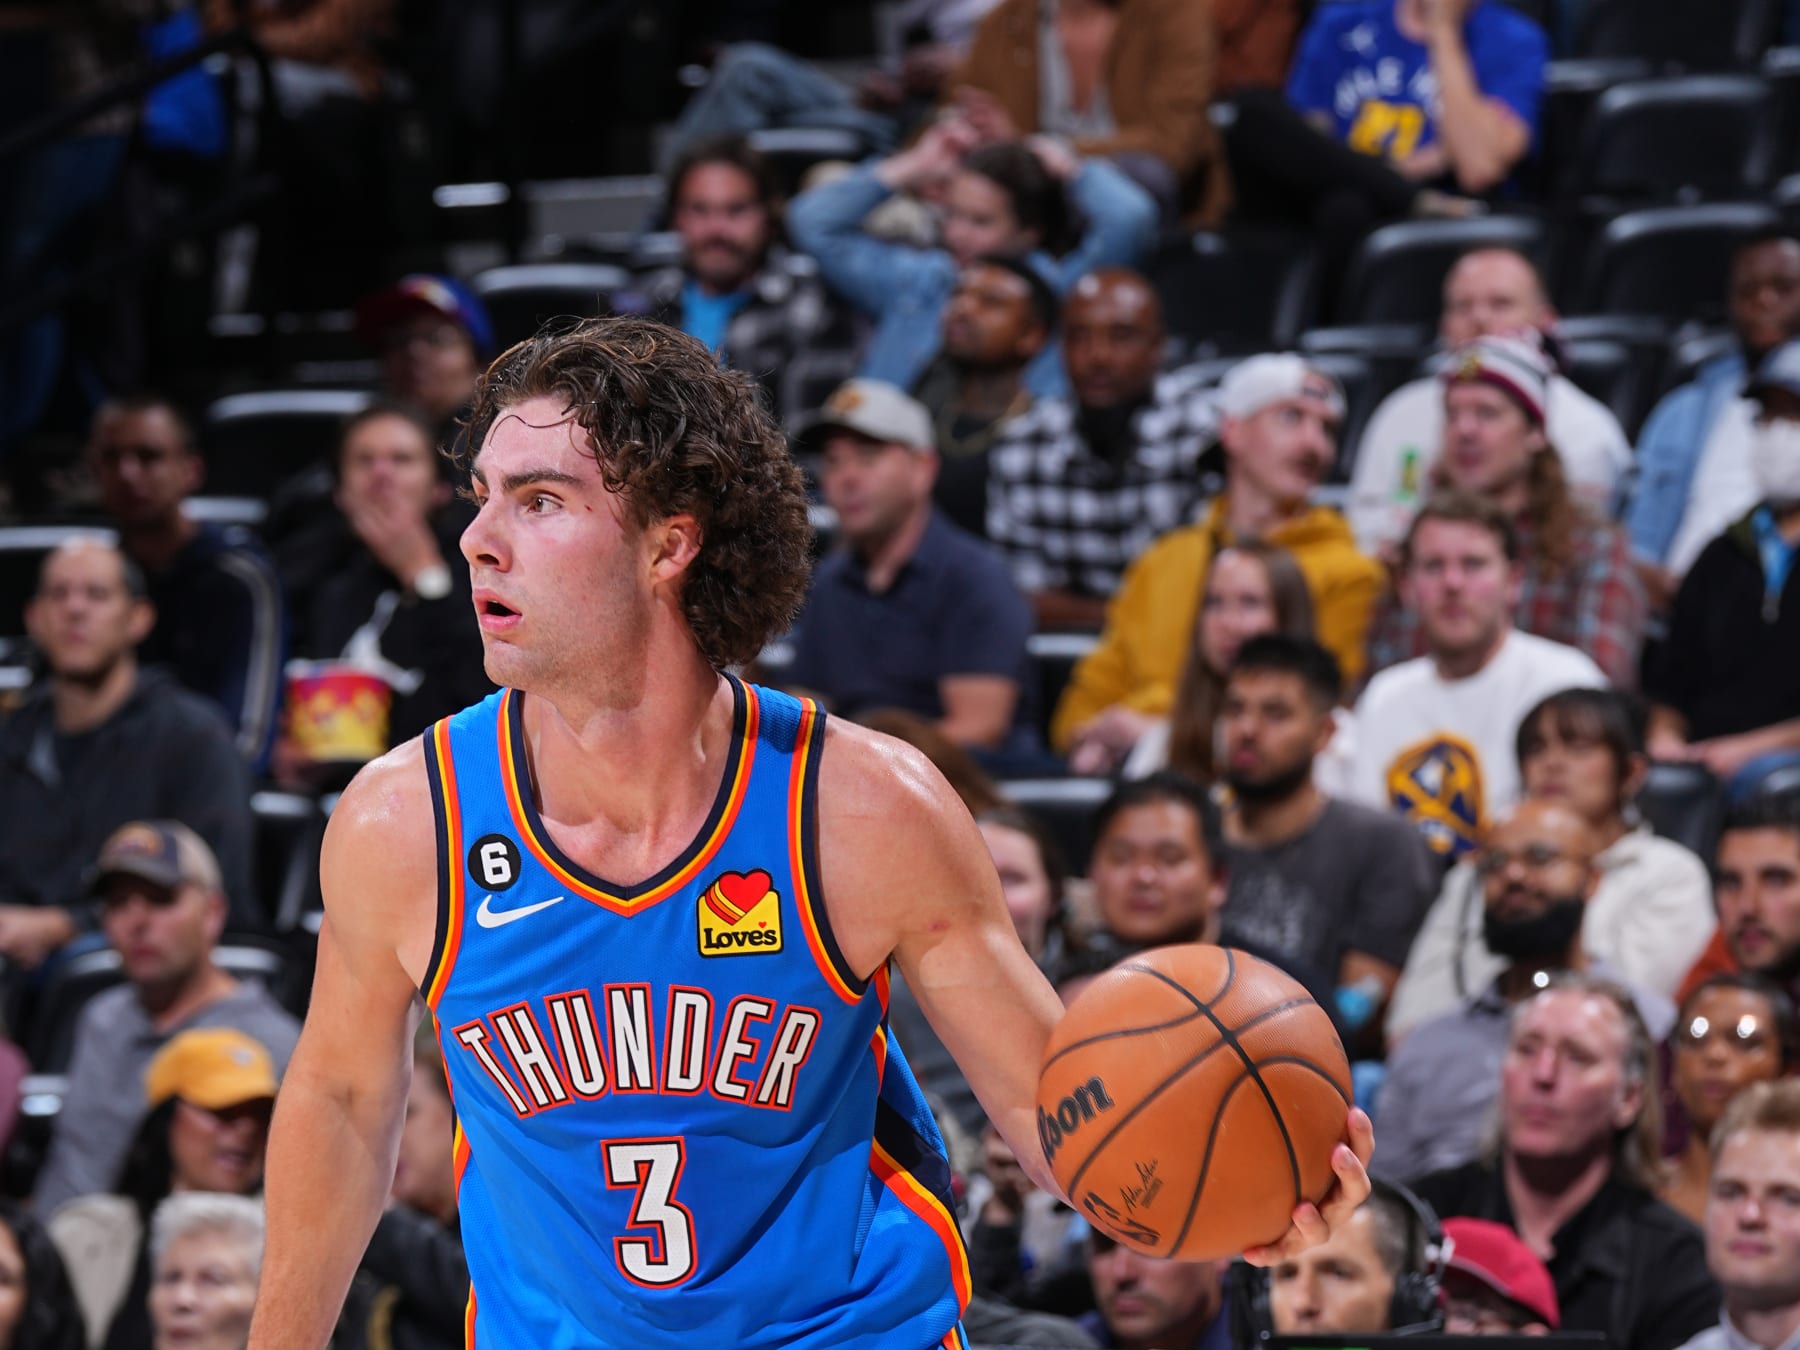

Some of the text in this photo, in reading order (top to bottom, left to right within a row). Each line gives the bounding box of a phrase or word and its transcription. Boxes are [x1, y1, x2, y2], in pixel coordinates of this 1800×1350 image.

[480, 842, 511, 885] 6
[452, 983, 822, 1118] THUNDER
[600, 1136, 698, 1289] 3
